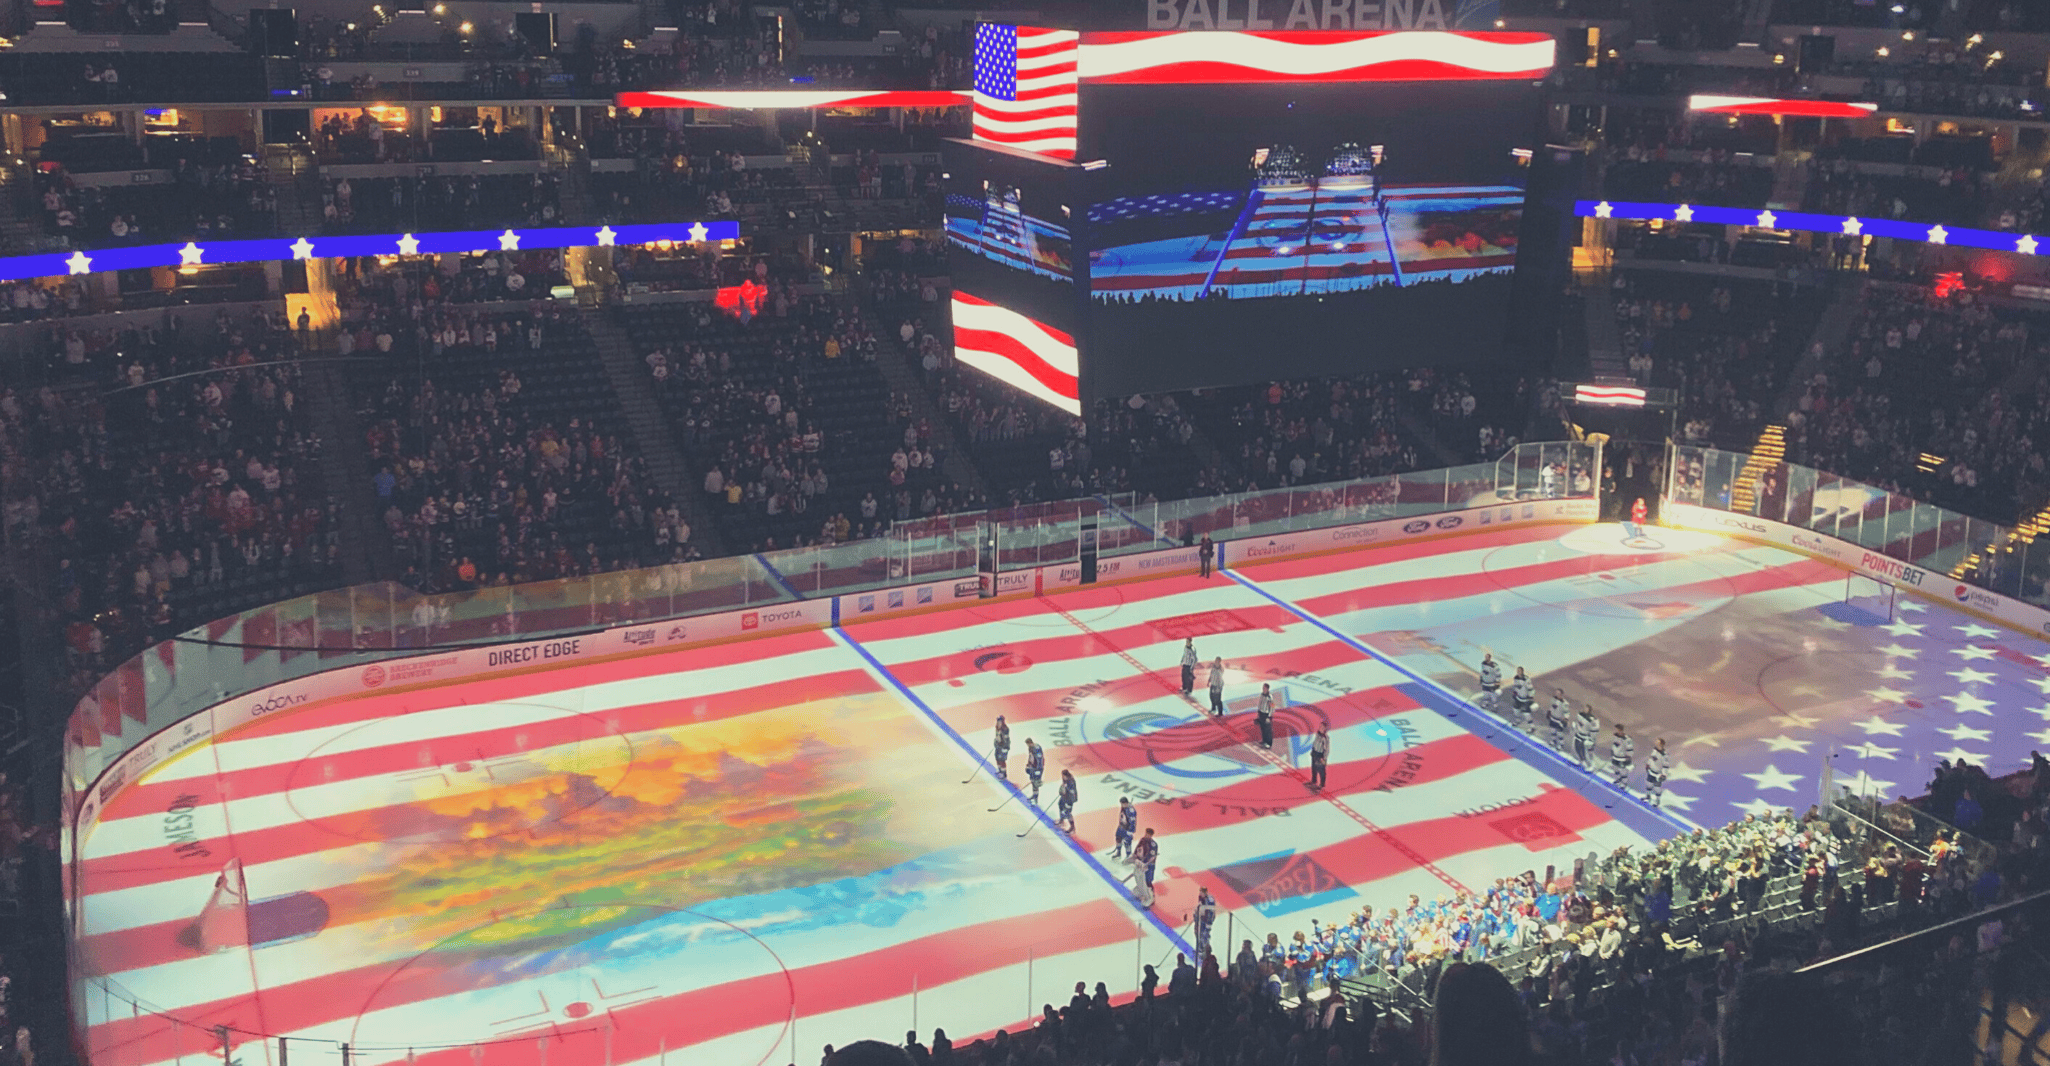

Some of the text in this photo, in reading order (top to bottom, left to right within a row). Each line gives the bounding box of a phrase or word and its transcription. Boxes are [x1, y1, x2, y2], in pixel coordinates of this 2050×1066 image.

[1146, 0, 1273, 30] BALL
[1285, 0, 1447, 30] ARENA
[1138, 559, 1151, 569] NEW
[1152, 555, 1188, 567] AMSTERDAM
[998, 574, 1029, 586] TRULY
[762, 610, 802, 624] TOYOTA
[488, 639, 581, 667] DIRECT EDGE
[1048, 679, 1114, 747] BALL ARENA
[1371, 718, 1426, 793] BALL ARENA
[1100, 773, 1292, 818] BALL ARENA
[164, 793, 211, 860] JAMESON
